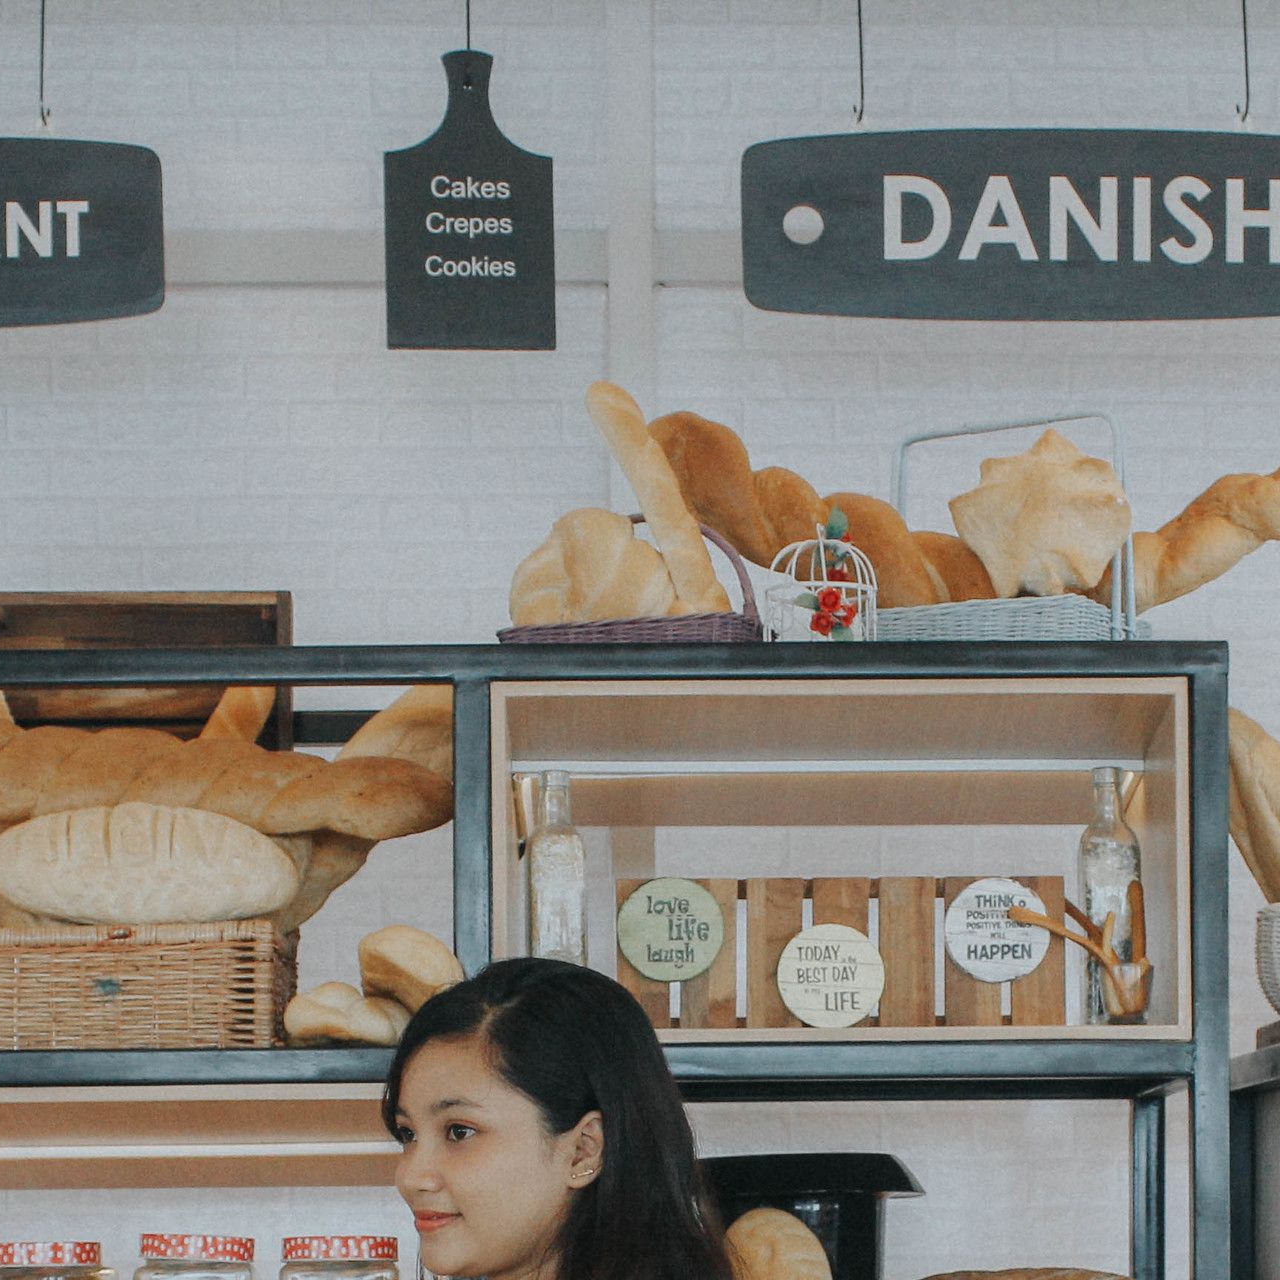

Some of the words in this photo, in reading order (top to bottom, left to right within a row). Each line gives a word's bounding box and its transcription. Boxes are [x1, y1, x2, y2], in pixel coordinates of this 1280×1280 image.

[430, 175, 512, 199] Cakes
[425, 212, 513, 239] Crepes
[425, 255, 516, 276] Cookies
[646, 895, 689, 914] love
[646, 942, 694, 969] laugh
[797, 945, 840, 962] TODAY
[967, 943, 1032, 960] HAPPEN
[797, 966, 828, 984] BEST
[832, 965, 857, 982] DAY
[824, 991, 860, 1012] LIFE
